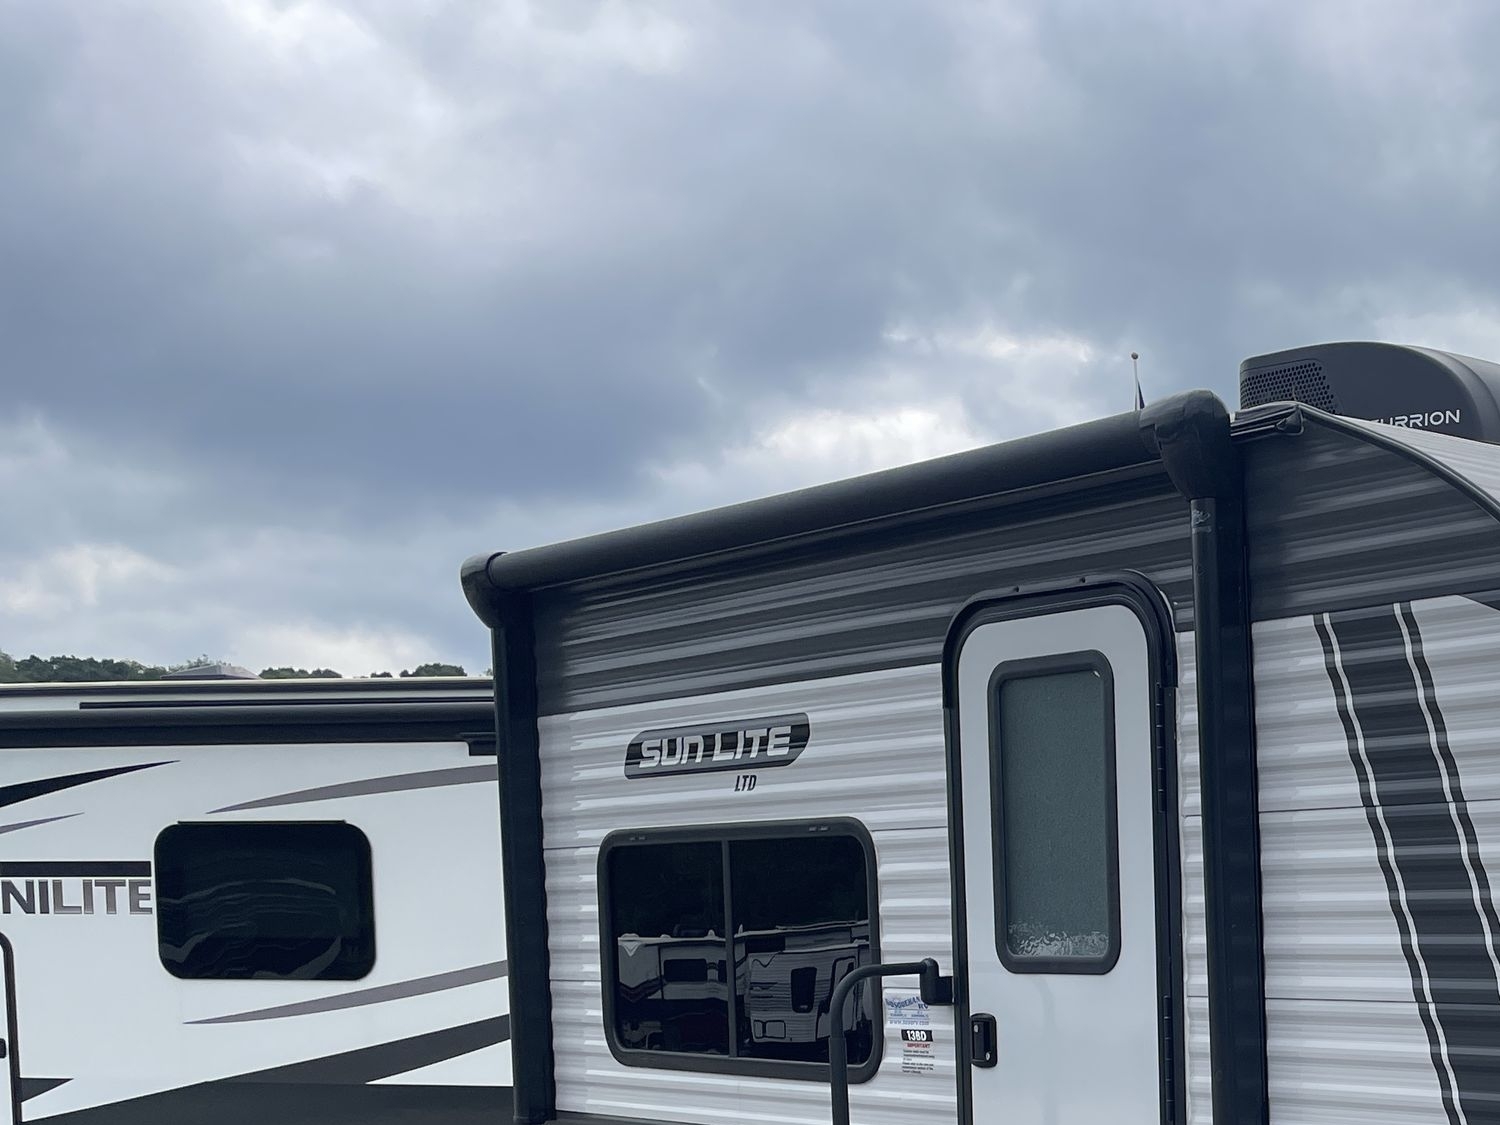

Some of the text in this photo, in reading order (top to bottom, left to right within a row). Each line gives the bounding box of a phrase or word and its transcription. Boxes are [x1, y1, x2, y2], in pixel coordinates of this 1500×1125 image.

[639, 725, 792, 768] SUN LITE
[734, 774, 757, 792] LTD
[906, 1030, 927, 1042] 13BD
